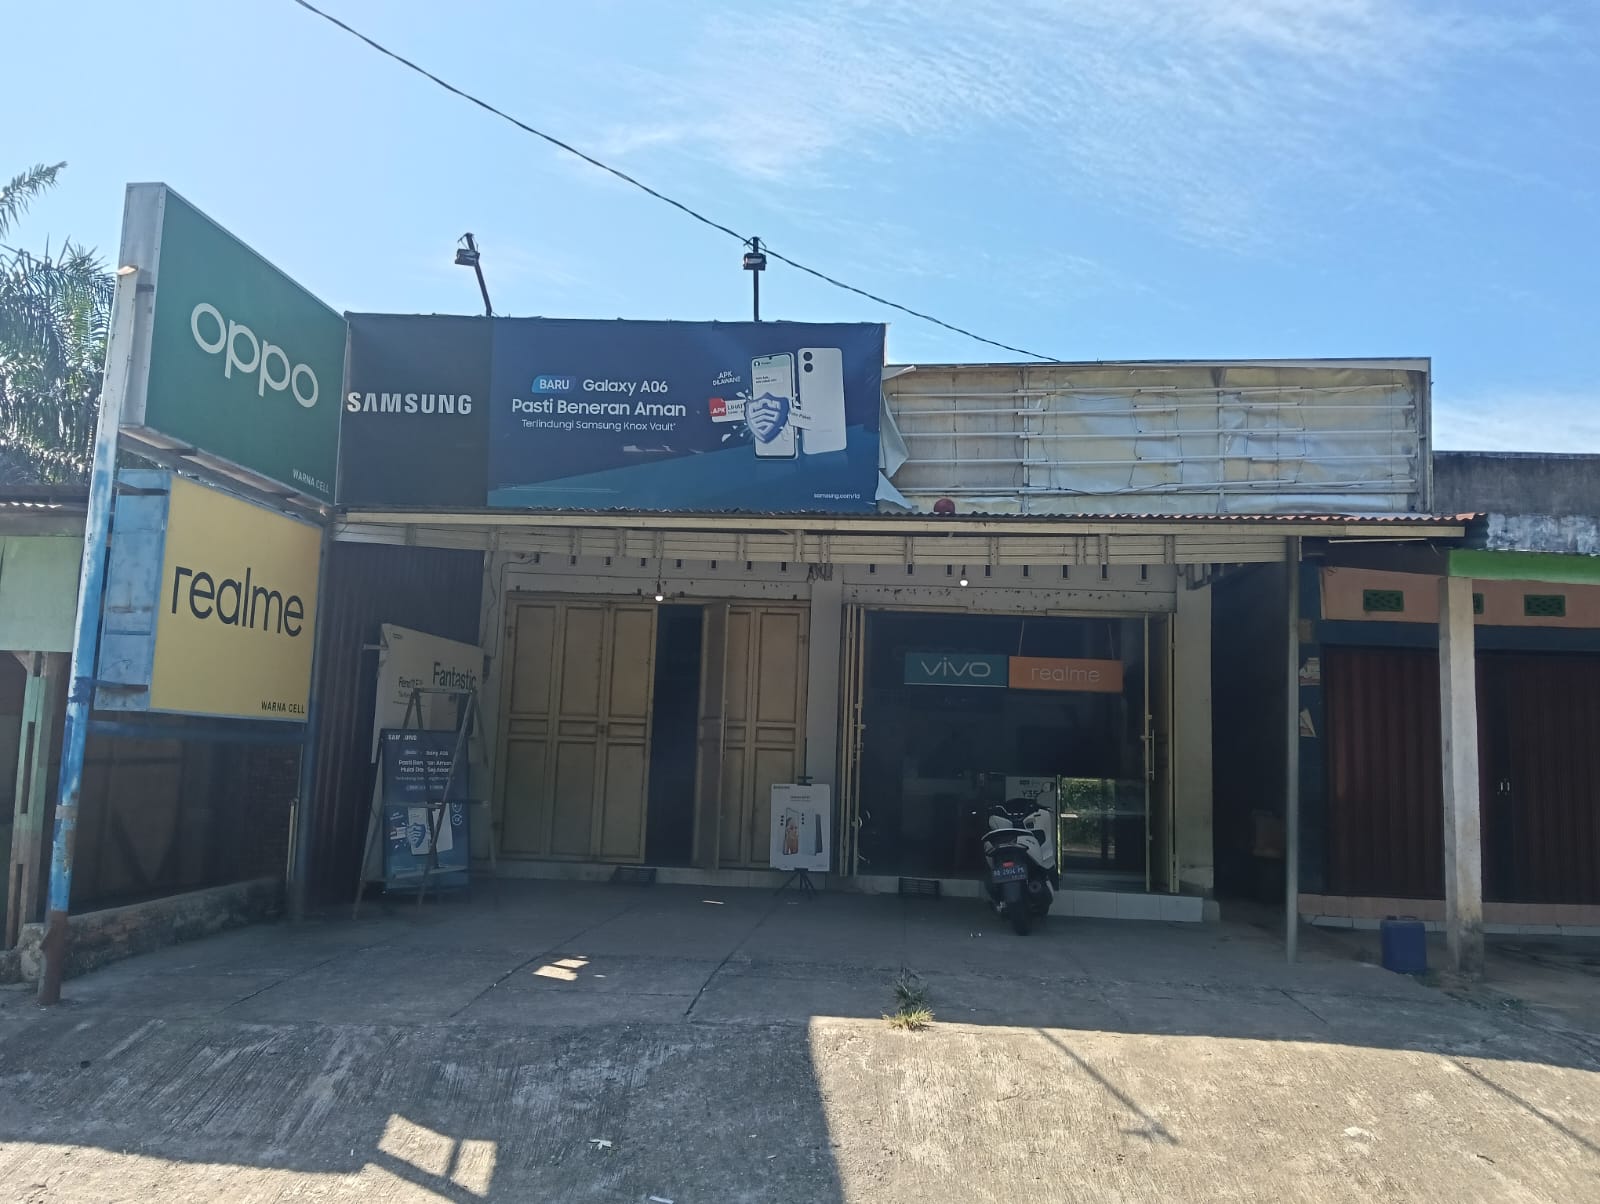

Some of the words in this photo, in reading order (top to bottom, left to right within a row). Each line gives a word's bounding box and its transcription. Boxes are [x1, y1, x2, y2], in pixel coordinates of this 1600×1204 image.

[190, 302, 319, 408] oppo
[539, 379, 570, 390] BARU
[582, 379, 636, 396] Galaxy
[639, 380, 669, 393] A06
[346, 391, 473, 415] SAMSUNG
[511, 398, 554, 414] Pasti
[557, 400, 630, 416] Beneran
[634, 401, 687, 417] Aman
[522, 418, 574, 432] Terlindungi
[576, 420, 621, 433] Samsung
[623, 421, 648, 432] Knox
[171, 565, 304, 638] realme
[432, 661, 477, 690] Fantastic
[920, 656, 992, 678] vivo
[1030, 664, 1101, 683] realme
[261, 699, 287, 712] WARNA
[288, 703, 305, 714] CELL
